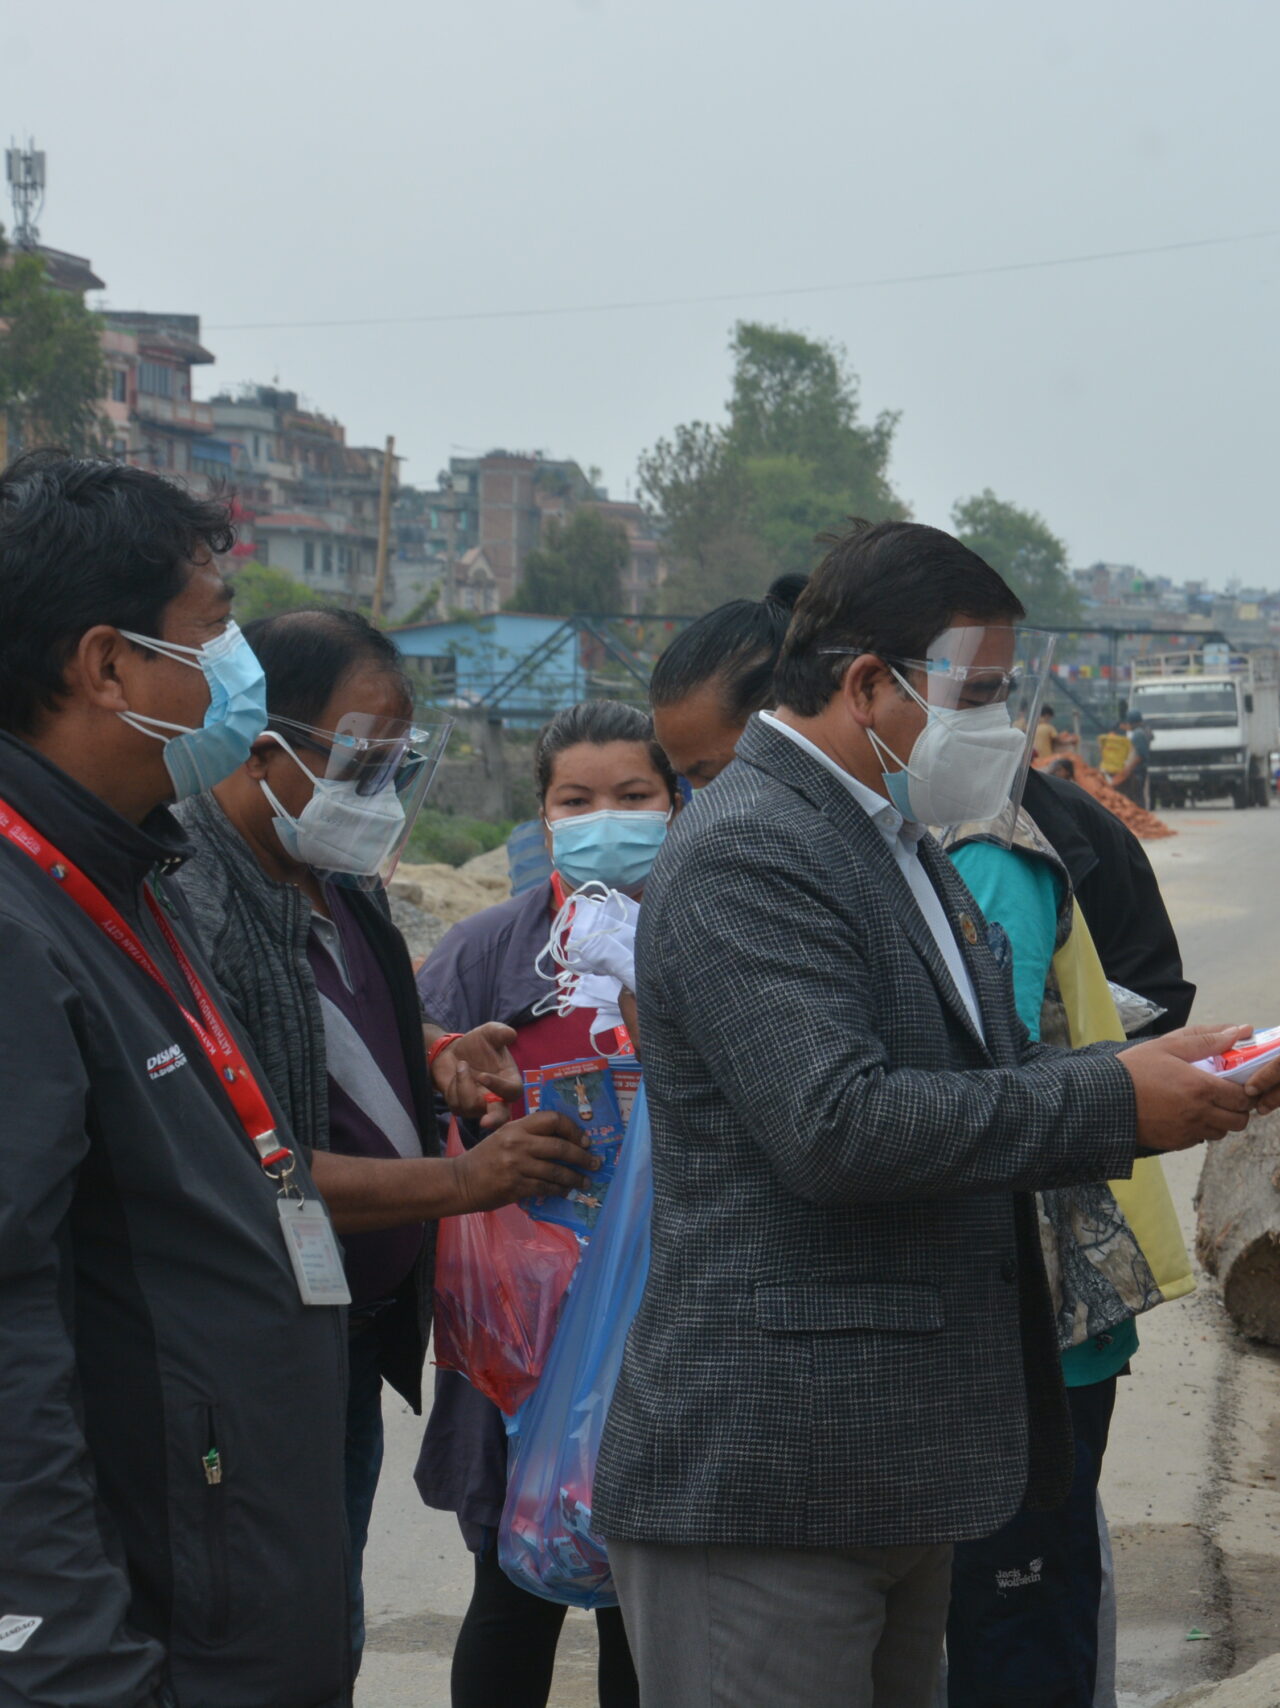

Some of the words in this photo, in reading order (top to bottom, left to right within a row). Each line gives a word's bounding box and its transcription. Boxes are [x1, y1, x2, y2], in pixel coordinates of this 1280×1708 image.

[103, 919, 124, 940] CITY
[200, 998, 233, 1056] KATHMANDU
[995, 1568, 1021, 1579] Jack
[997, 1573, 1041, 1588] Wolfskin
